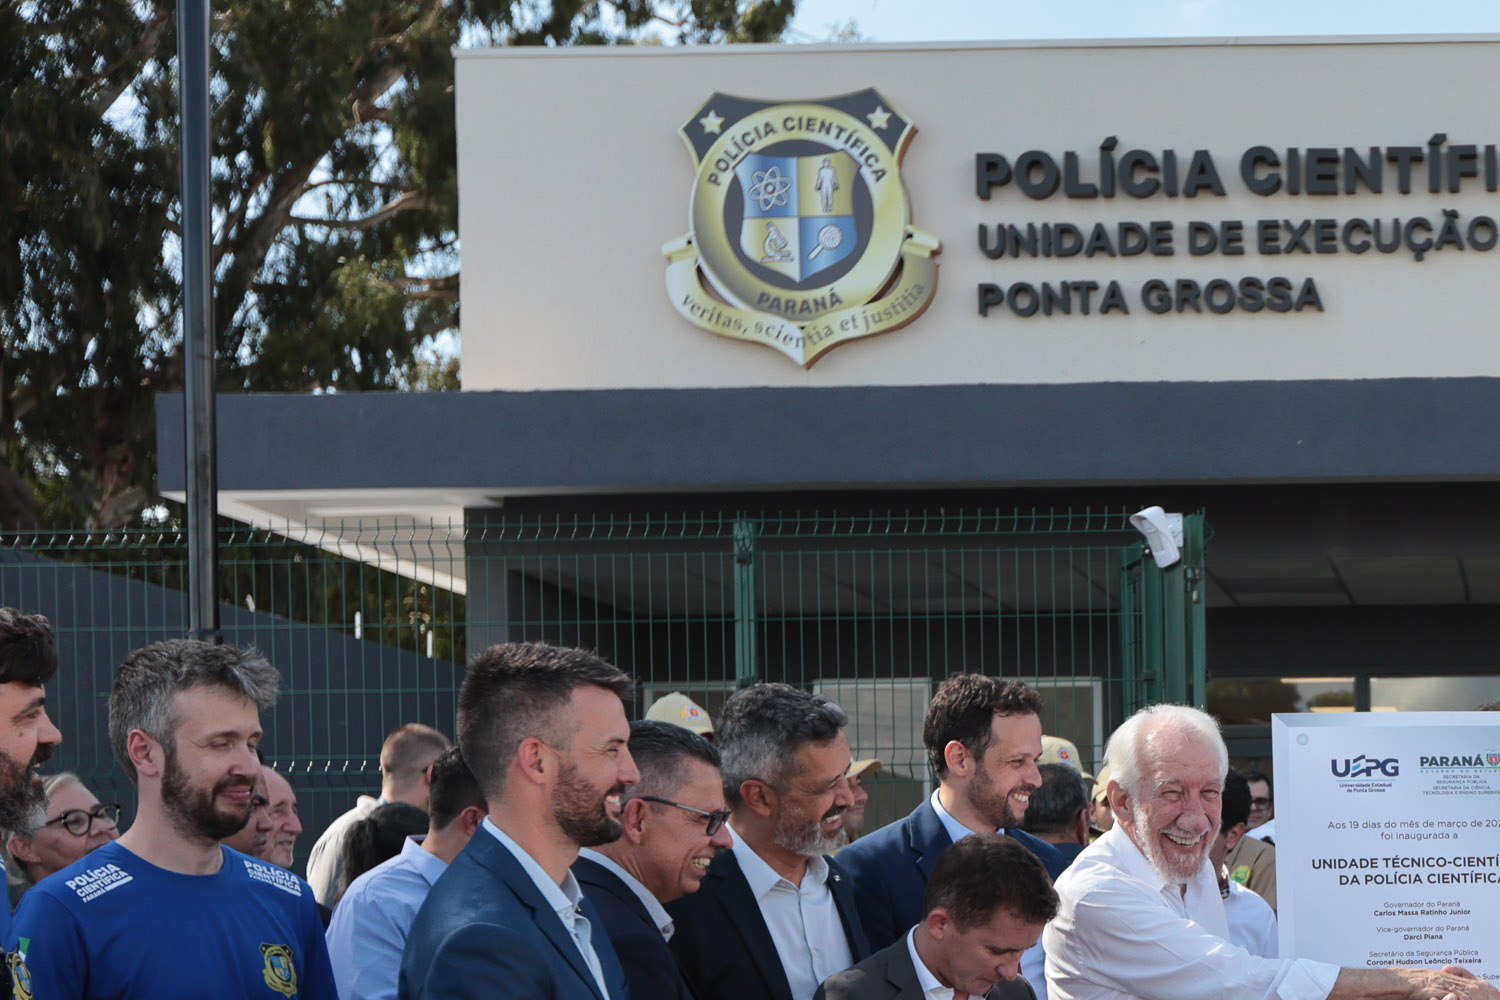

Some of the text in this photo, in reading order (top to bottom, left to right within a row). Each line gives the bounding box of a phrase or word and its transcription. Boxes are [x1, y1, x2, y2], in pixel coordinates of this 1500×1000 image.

[706, 115, 888, 187] POLÍCIA CIENTÍFICA
[975, 135, 1227, 200] POLÍCIA
[978, 220, 1175, 260] UNIDADE
[1187, 219, 1245, 256] DE
[1257, 208, 1499, 262] EXECUÇÃO
[756, 287, 844, 316] PARANÁ
[978, 276, 1324, 317] PONTA GROSSA
[839, 314, 859, 333] et
[1331, 754, 1400, 778] UEPG
[1419, 753, 1485, 767] PARANÁ
[1328, 821, 1347, 830] Aos
[1349, 820, 1359, 829] 19
[1361, 820, 1382, 829] dias
[1384, 820, 1398, 829] do
[1400, 819, 1420, 829] mês
[1422, 819, 1436, 828] de
[1437, 820, 1468, 830] março
[1470, 819, 1483, 828] de
[1380, 831, 1459, 841] foi inaugurada a
[243, 859, 300, 885] POLÍCIA
[1311, 857, 1379, 869] UNIDADE
[65, 863, 121, 890] POLÍCIA
[76, 870, 129, 898] CIENTÍFICA
[1339, 875, 1361, 886] DA
[1365, 870, 1423, 885] POLÍCIA
[1383, 901, 1425, 909] Governador
[1436, 900, 1461, 908] Paraná
[1376, 925, 1434, 934] Vice-governador
[1369, 950, 1404, 958] Secretário
[1416, 950, 1453, 959] Segurança
[1453, 949, 1479, 957] Pública
